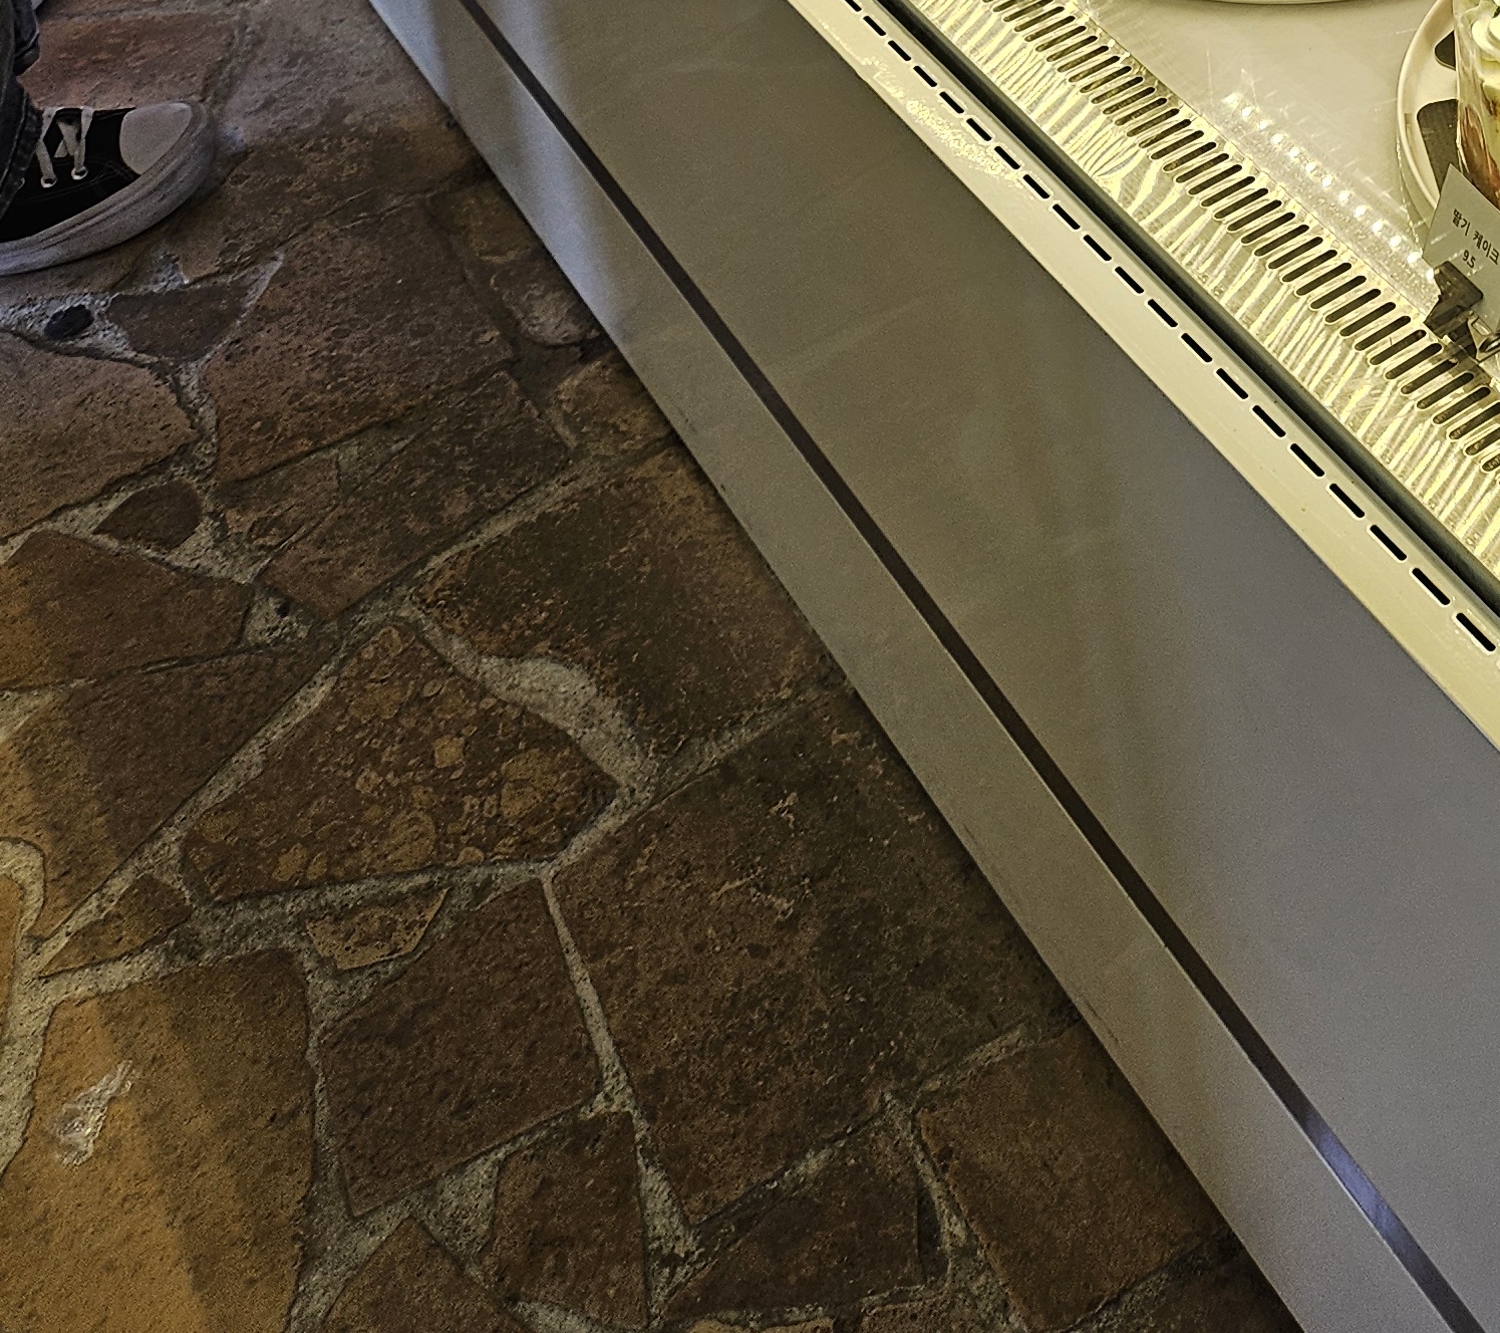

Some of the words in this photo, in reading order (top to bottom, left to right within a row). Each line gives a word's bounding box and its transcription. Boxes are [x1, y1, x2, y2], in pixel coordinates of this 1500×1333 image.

[1452, 208, 1471, 237] 딸기
[1472, 230, 1500, 266] 케이크
[1462, 249, 1476, 270] 9.5
